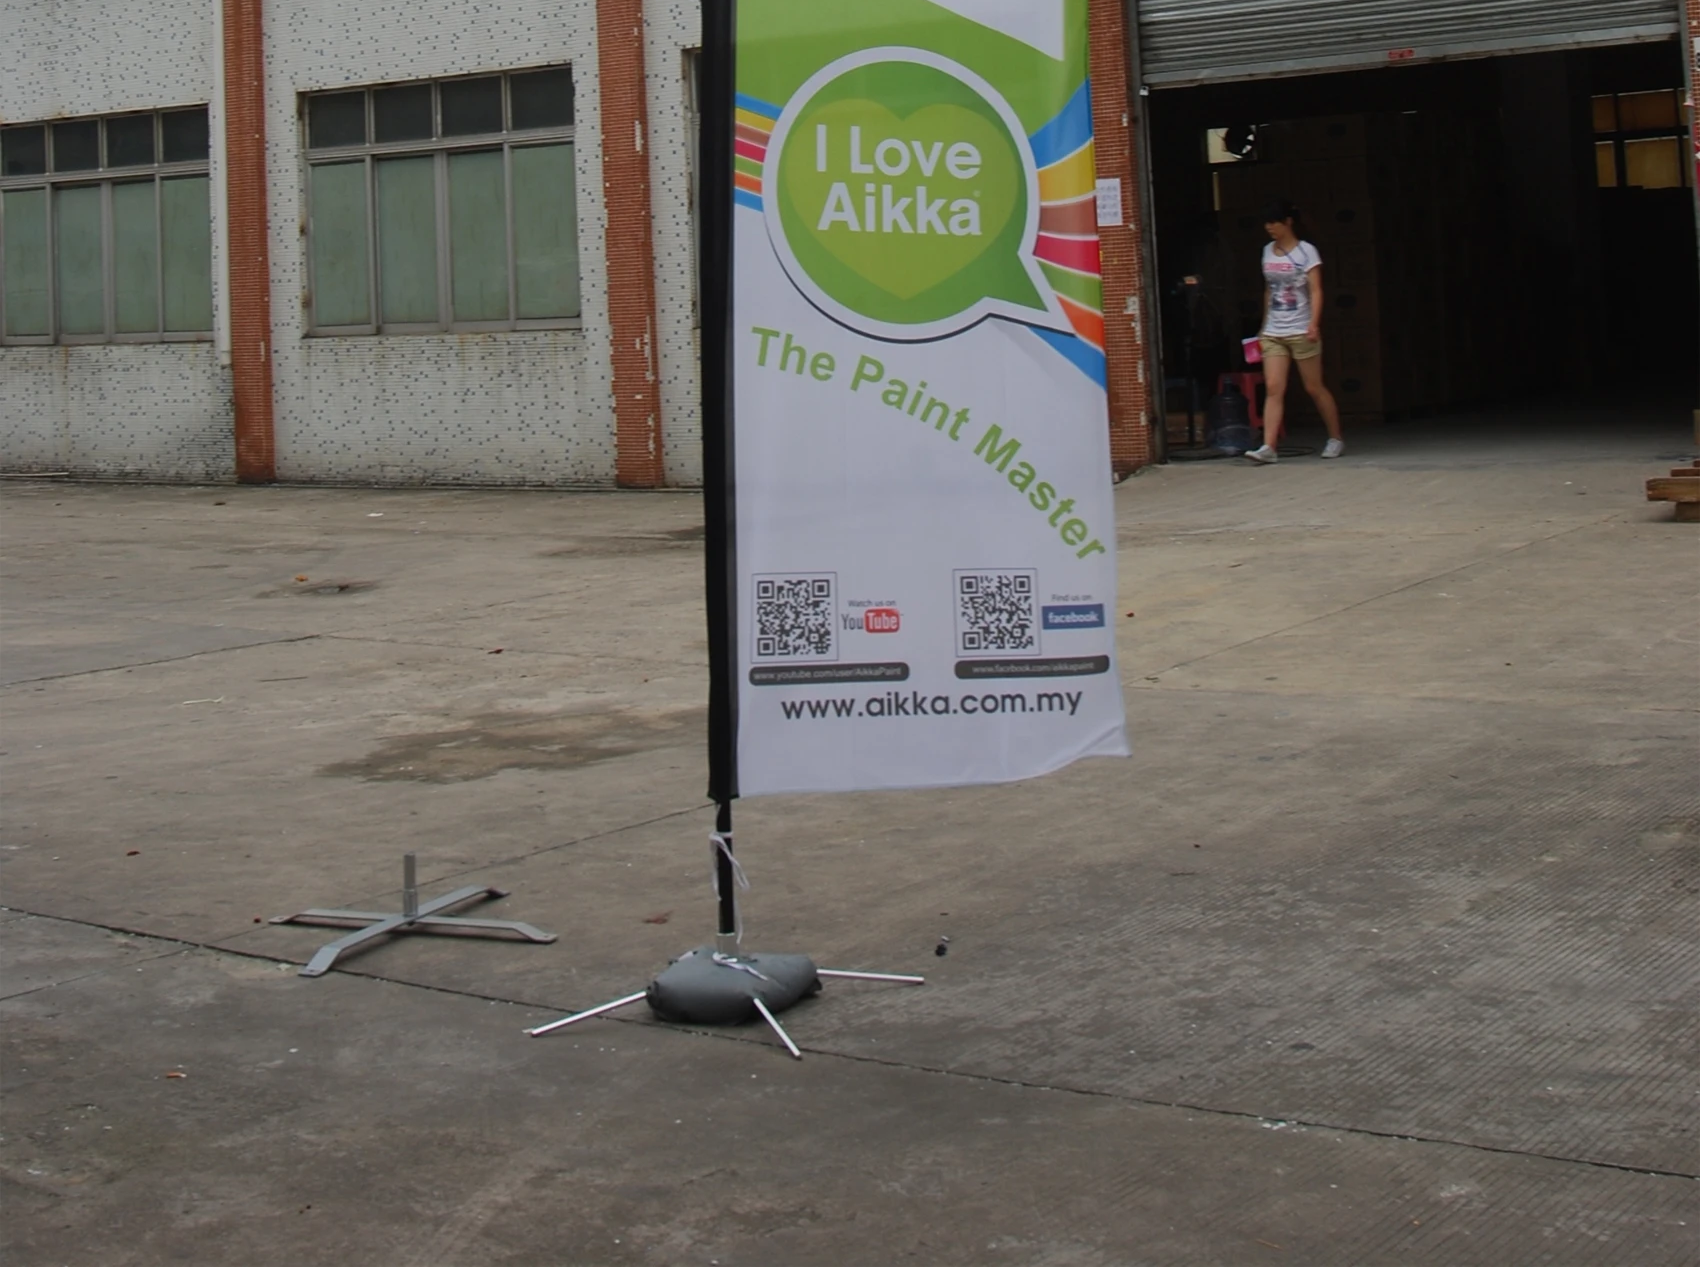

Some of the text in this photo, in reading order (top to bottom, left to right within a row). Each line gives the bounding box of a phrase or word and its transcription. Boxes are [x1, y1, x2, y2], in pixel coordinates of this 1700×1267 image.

[815, 124, 982, 179] I Love
[817, 181, 983, 236] Aikka
[751, 325, 1106, 560] The Paint Master
[1048, 610, 1100, 623] facebook
[781, 689, 1083, 720] www.aikka.com.my
